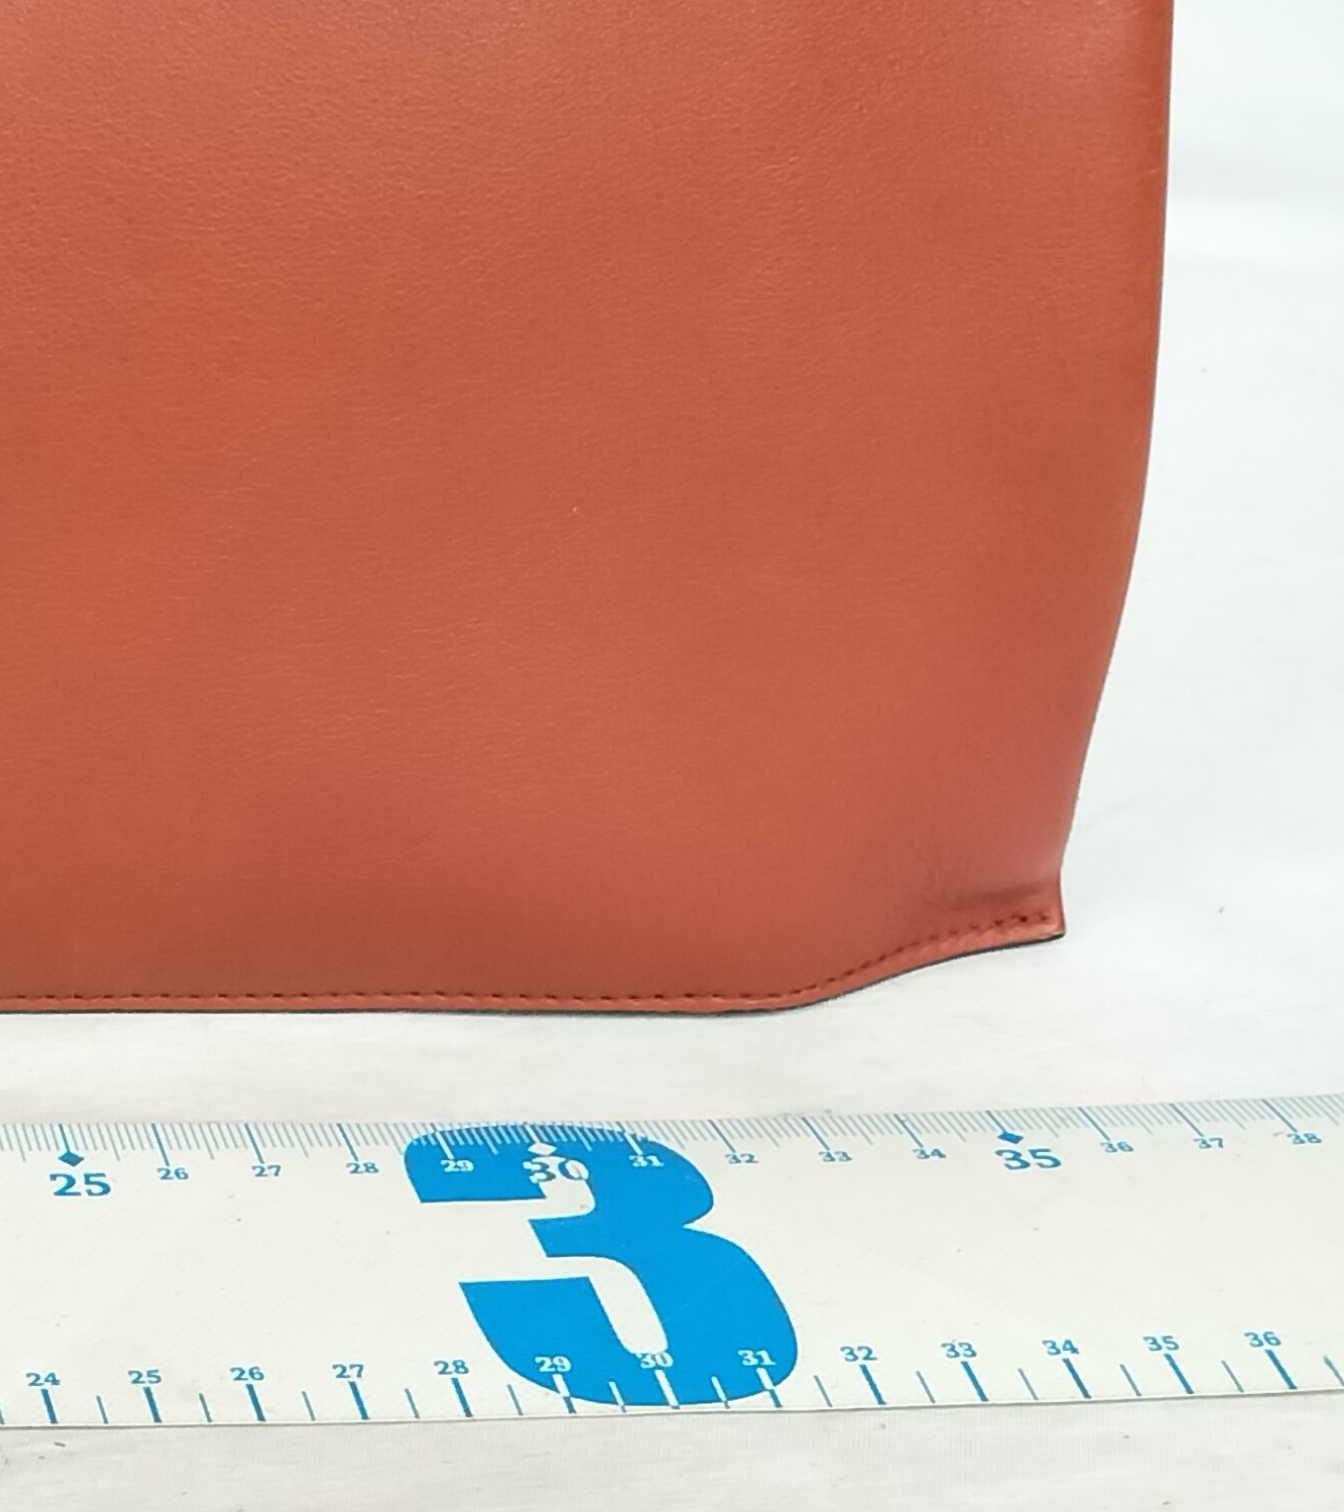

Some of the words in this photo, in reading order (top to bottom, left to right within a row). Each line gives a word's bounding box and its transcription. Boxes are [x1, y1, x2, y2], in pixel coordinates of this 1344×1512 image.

[49, 1172, 112, 1197] 25
[157, 1167, 189, 1180] 26
[251, 1164, 282, 1177] 27
[346, 1162, 379, 1174] 28
[441, 1160, 474, 1172] 29
[523, 1157, 590, 1183] 30
[629, 1155, 663, 1167] 31
[725, 1152, 759, 1164] 32
[819, 1150, 852, 1163] 33
[911, 1148, 946, 1160] 34
[995, 1148, 1062, 1169] 35
[1100, 1141, 1134, 1154] 36
[1193, 1136, 1226, 1150] 37
[1287, 1132, 1322, 1145] 38
[404, 1125, 798, 1407] 3
[26, 1372, 61, 1387] 24
[128, 1370, 162, 1385] 25
[230, 1366, 264, 1382] 26
[332, 1364, 365, 1379] 27
[434, 1360, 470, 1375] 28
[534, 1355, 572, 1373] 29
[639, 1351, 673, 1369] 30
[737, 1350, 775, 1366] 31
[840, 1346, 877, 1363] 32
[941, 1342, 977, 1359] 33
[1043, 1339, 1080, 1355] 34
[1143, 1336, 1180, 1352] 35
[1244, 1331, 1281, 1348] 36
